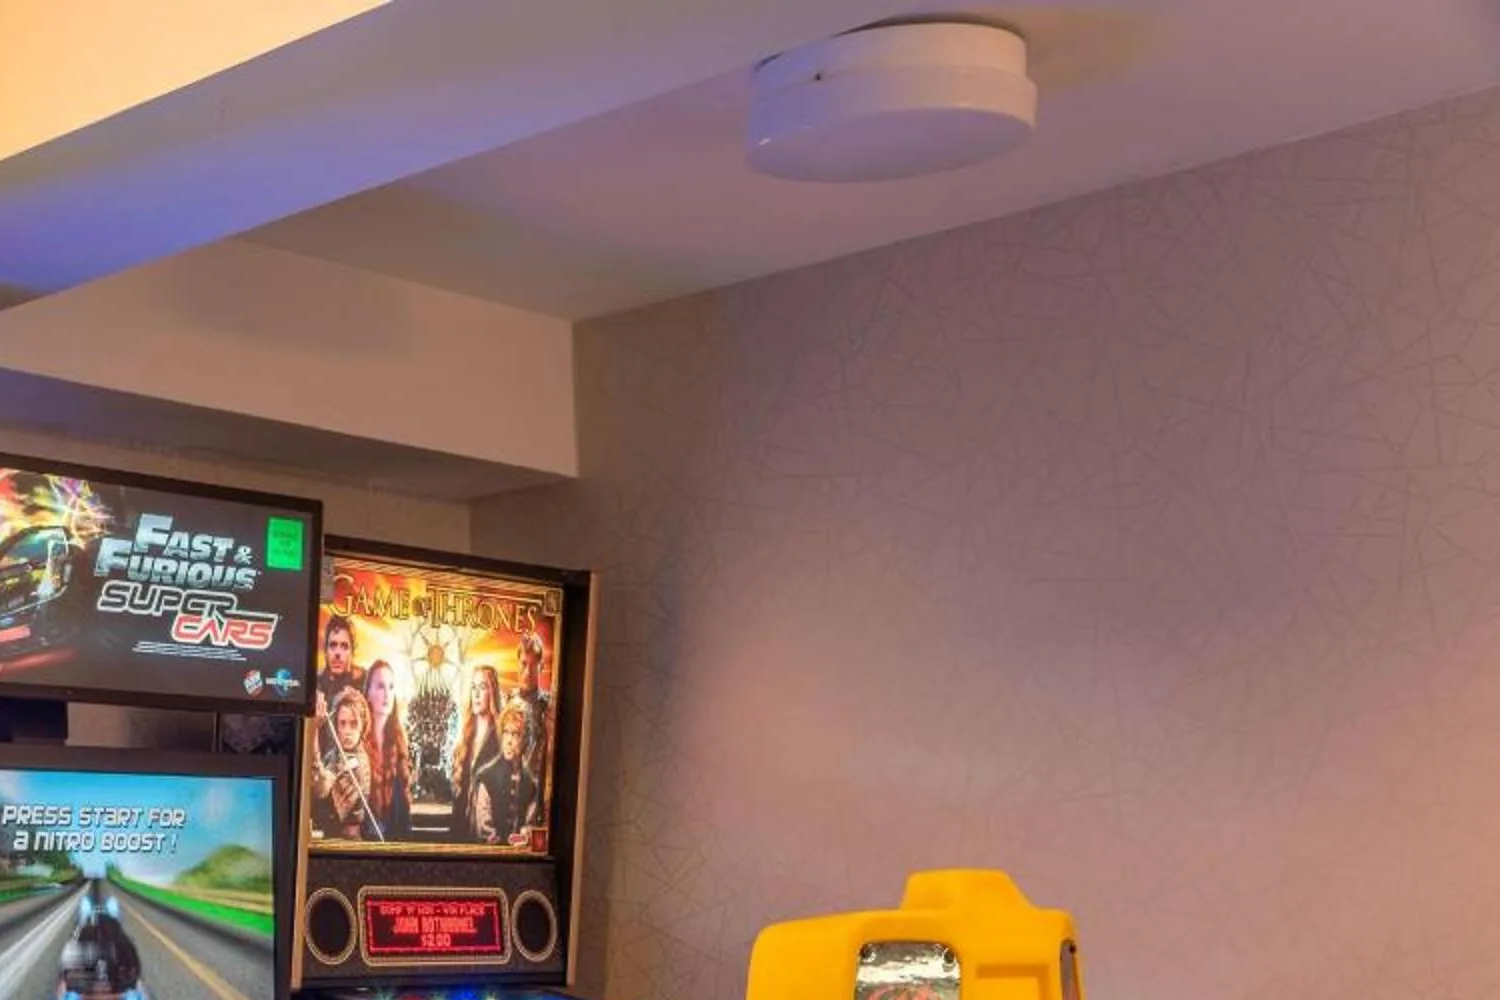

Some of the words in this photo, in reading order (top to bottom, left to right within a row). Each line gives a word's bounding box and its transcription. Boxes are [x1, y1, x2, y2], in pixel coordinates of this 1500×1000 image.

[134, 512, 235, 562] FAST
[234, 545, 254, 565] &
[94, 537, 258, 590] FURIOUS
[96, 579, 240, 619] SUPER
[332, 574, 412, 620] GAME
[426, 584, 541, 635] THRONES
[171, 613, 274, 651] CARS
[1, 804, 72, 827] PRESS
[147, 807, 186, 829] FOR
[34, 832, 95, 852] NITRO
[99, 832, 167, 853] BOOST
